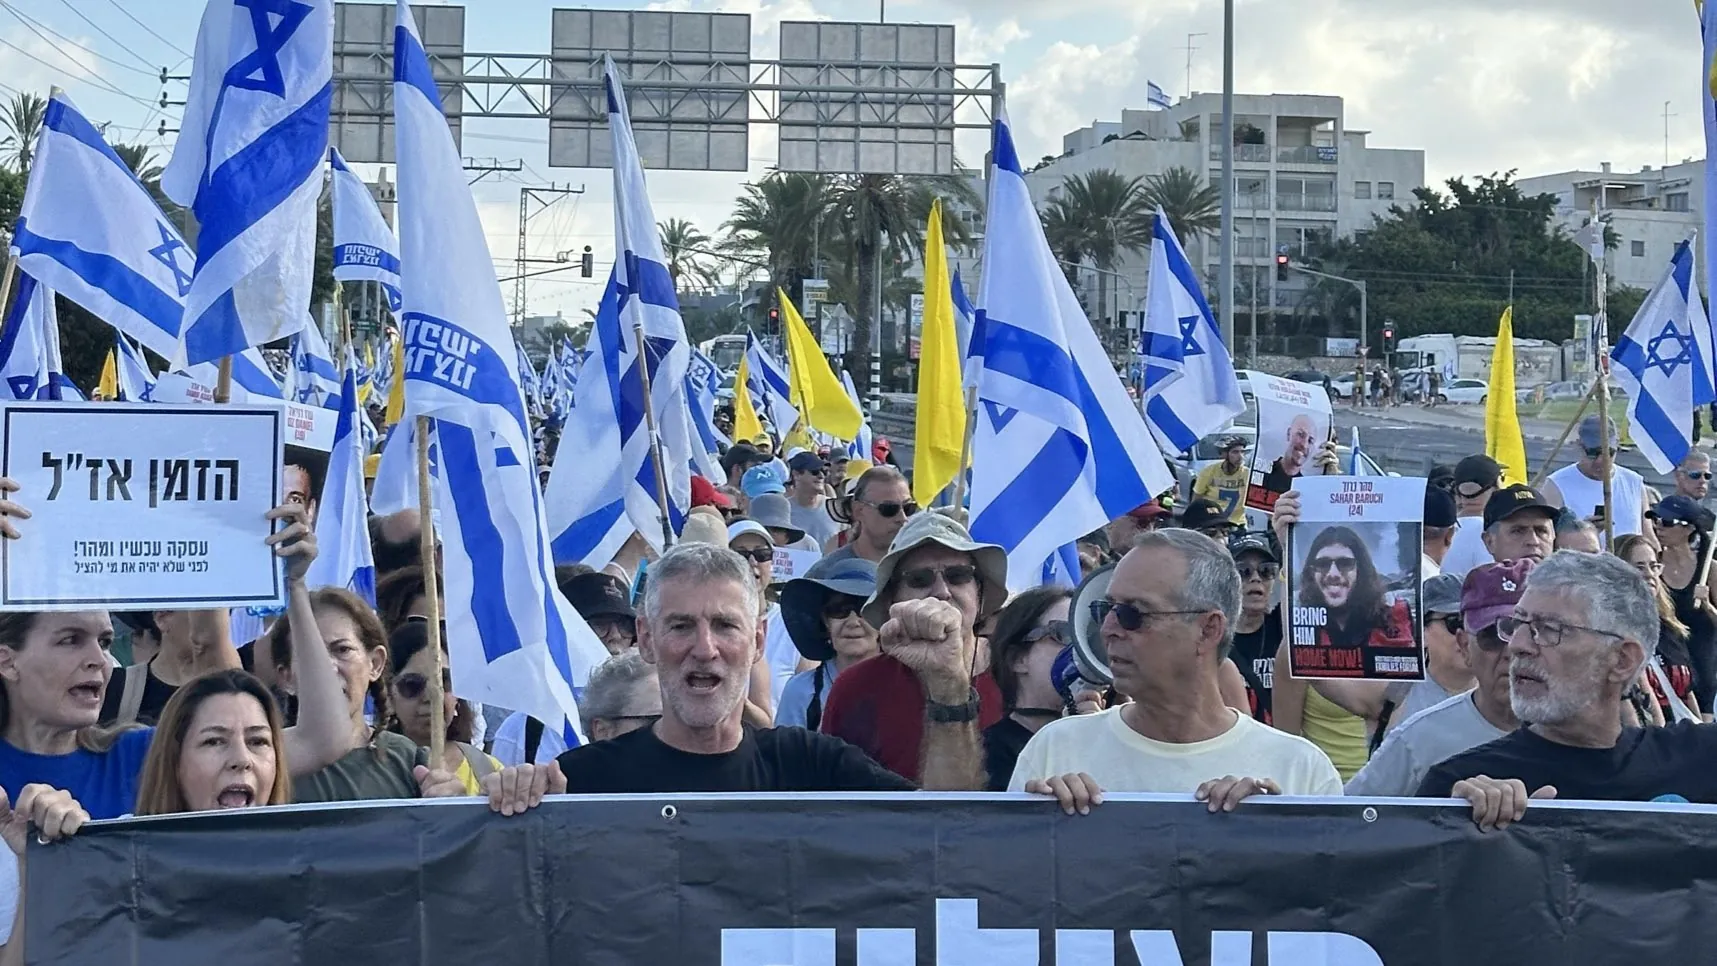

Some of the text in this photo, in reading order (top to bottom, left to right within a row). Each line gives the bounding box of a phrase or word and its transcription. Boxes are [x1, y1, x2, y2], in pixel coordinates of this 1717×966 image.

[149, 459, 239, 508] הזמן
[1330, 493, 1384, 504] SAHAR BARUCH
[1348, 504, 1363, 517] (24)
[74, 540, 208, 559] עסקה עכשיו ומהר!
[74, 560, 209, 574] לפני שלא יהיה את מי להציל
[1293, 606, 1328, 626] BRING
[1294, 626, 1316, 645] HIM
[1295, 647, 1363, 668] HOME NOW!
